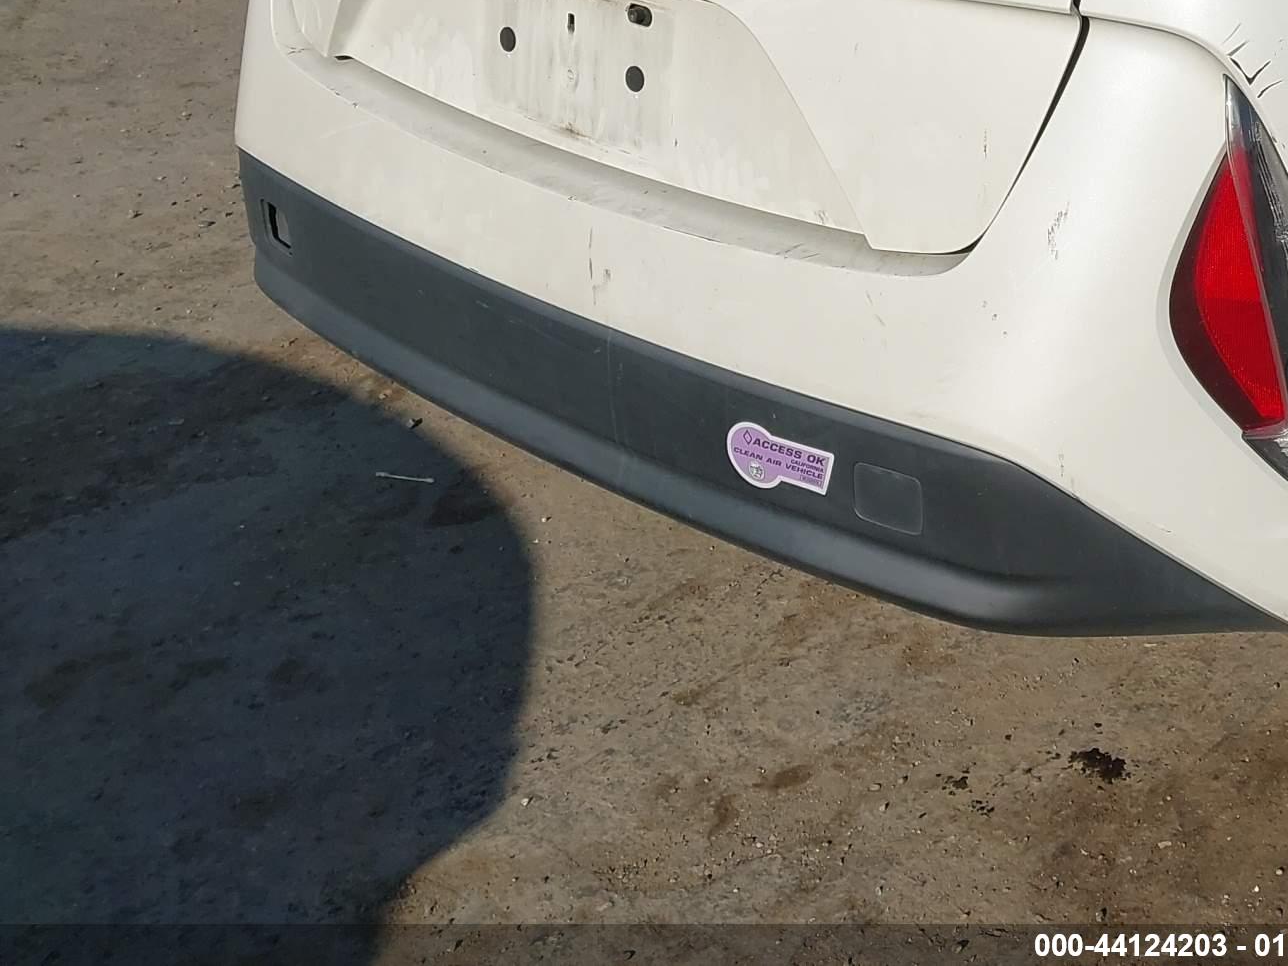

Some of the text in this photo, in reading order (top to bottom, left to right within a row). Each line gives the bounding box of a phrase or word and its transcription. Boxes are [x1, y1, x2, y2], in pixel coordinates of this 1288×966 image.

[733, 446, 824, 479] CLEAN AIR VEHICLE
[752, 437, 825, 467] ACCESS OK
[790, 458, 824, 473] CALIFORNIA
